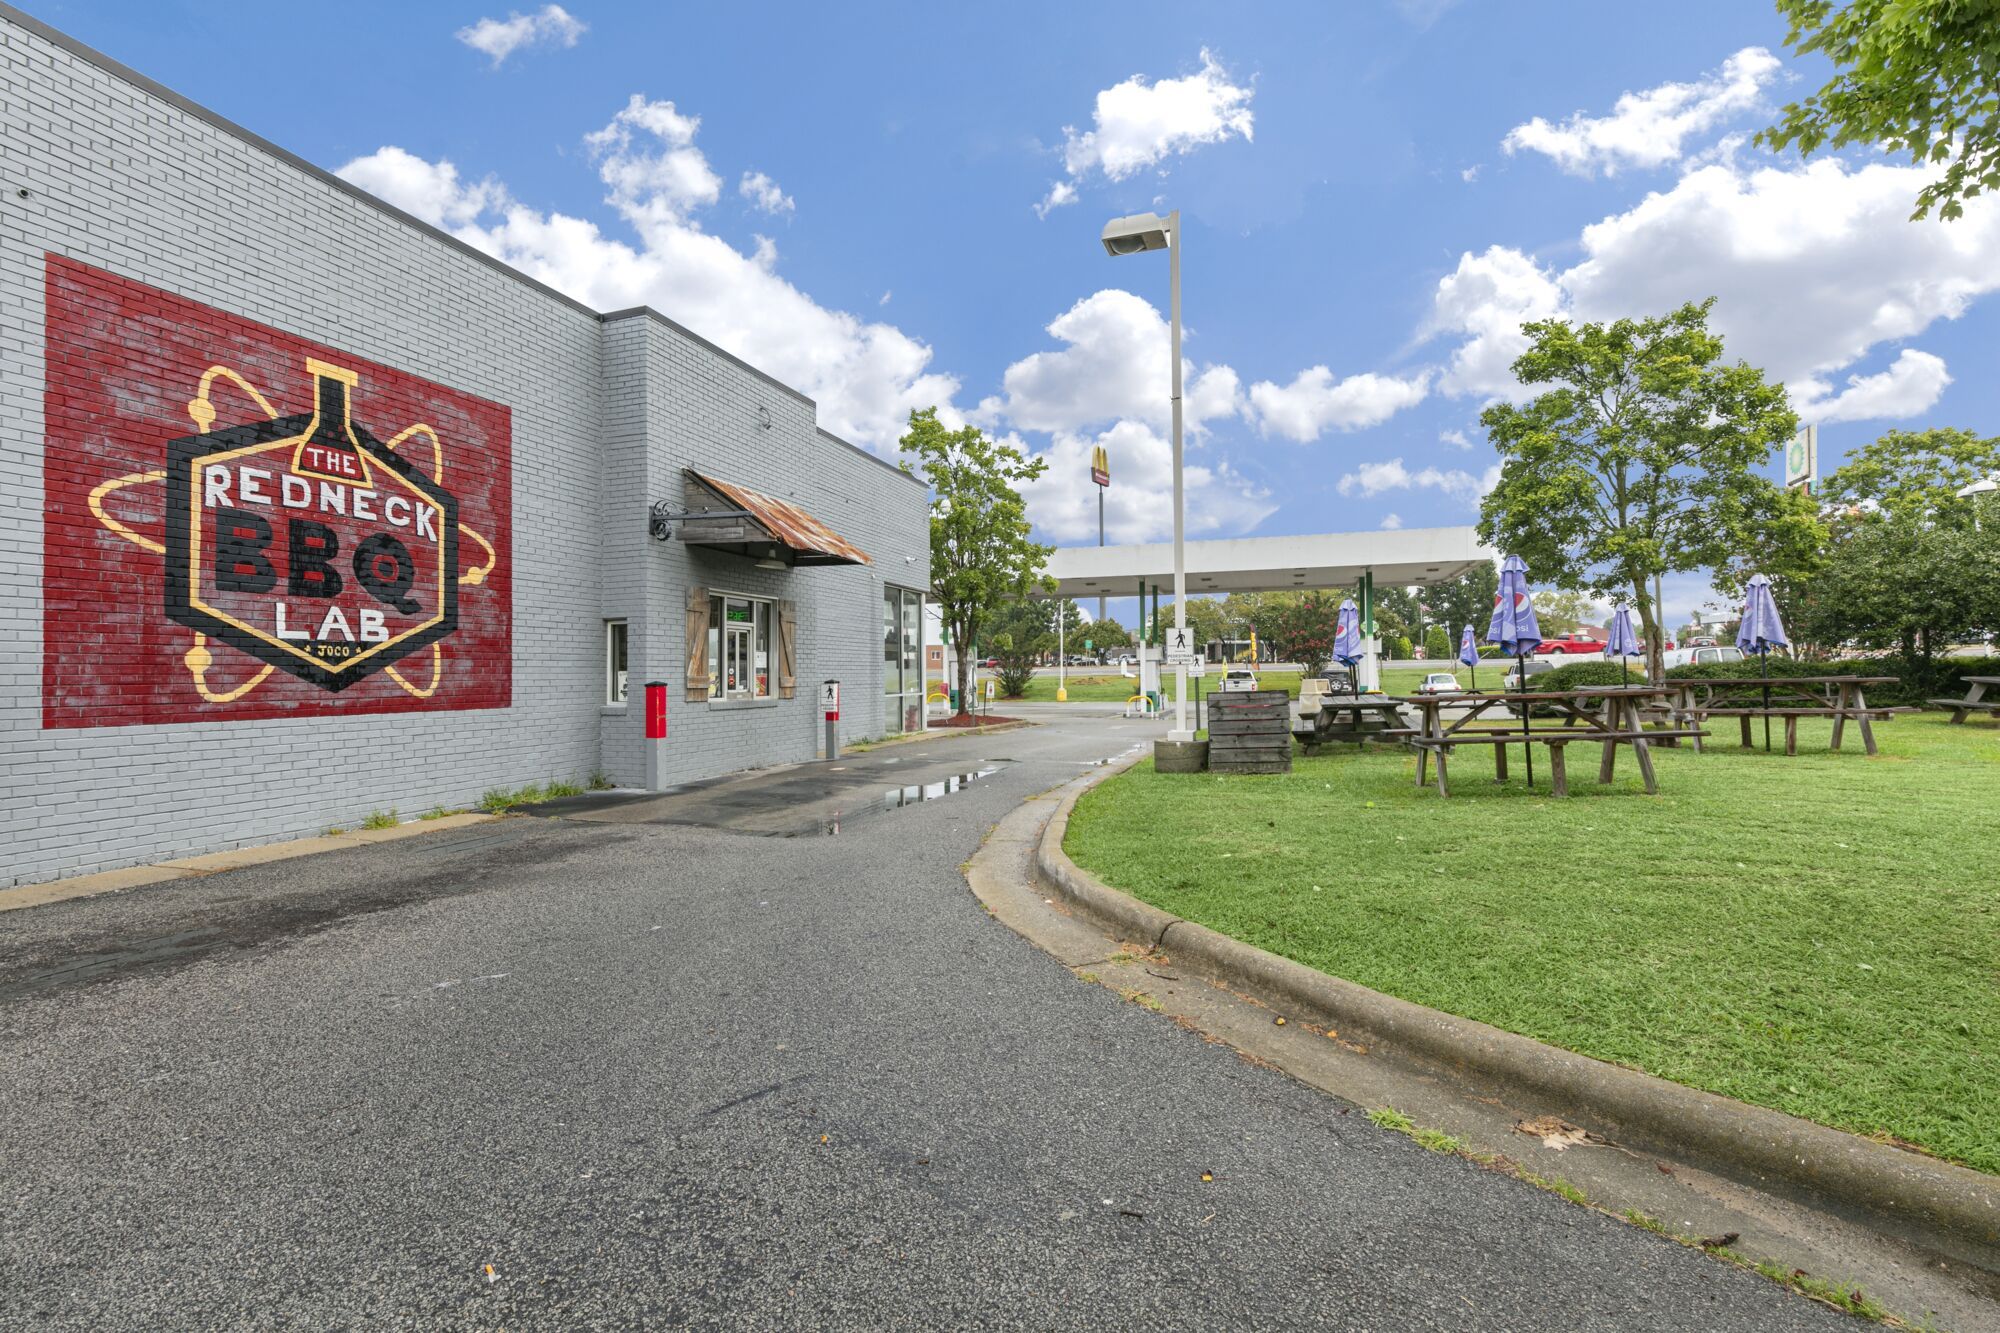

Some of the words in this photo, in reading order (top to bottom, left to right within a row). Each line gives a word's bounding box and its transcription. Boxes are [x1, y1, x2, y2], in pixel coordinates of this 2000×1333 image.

[306, 447, 356, 475] THE
[204, 464, 438, 542] REDNECK
[215, 508, 423, 615] BBQ
[275, 602, 390, 642] LAB
[317, 644, 350, 657] JOCO
